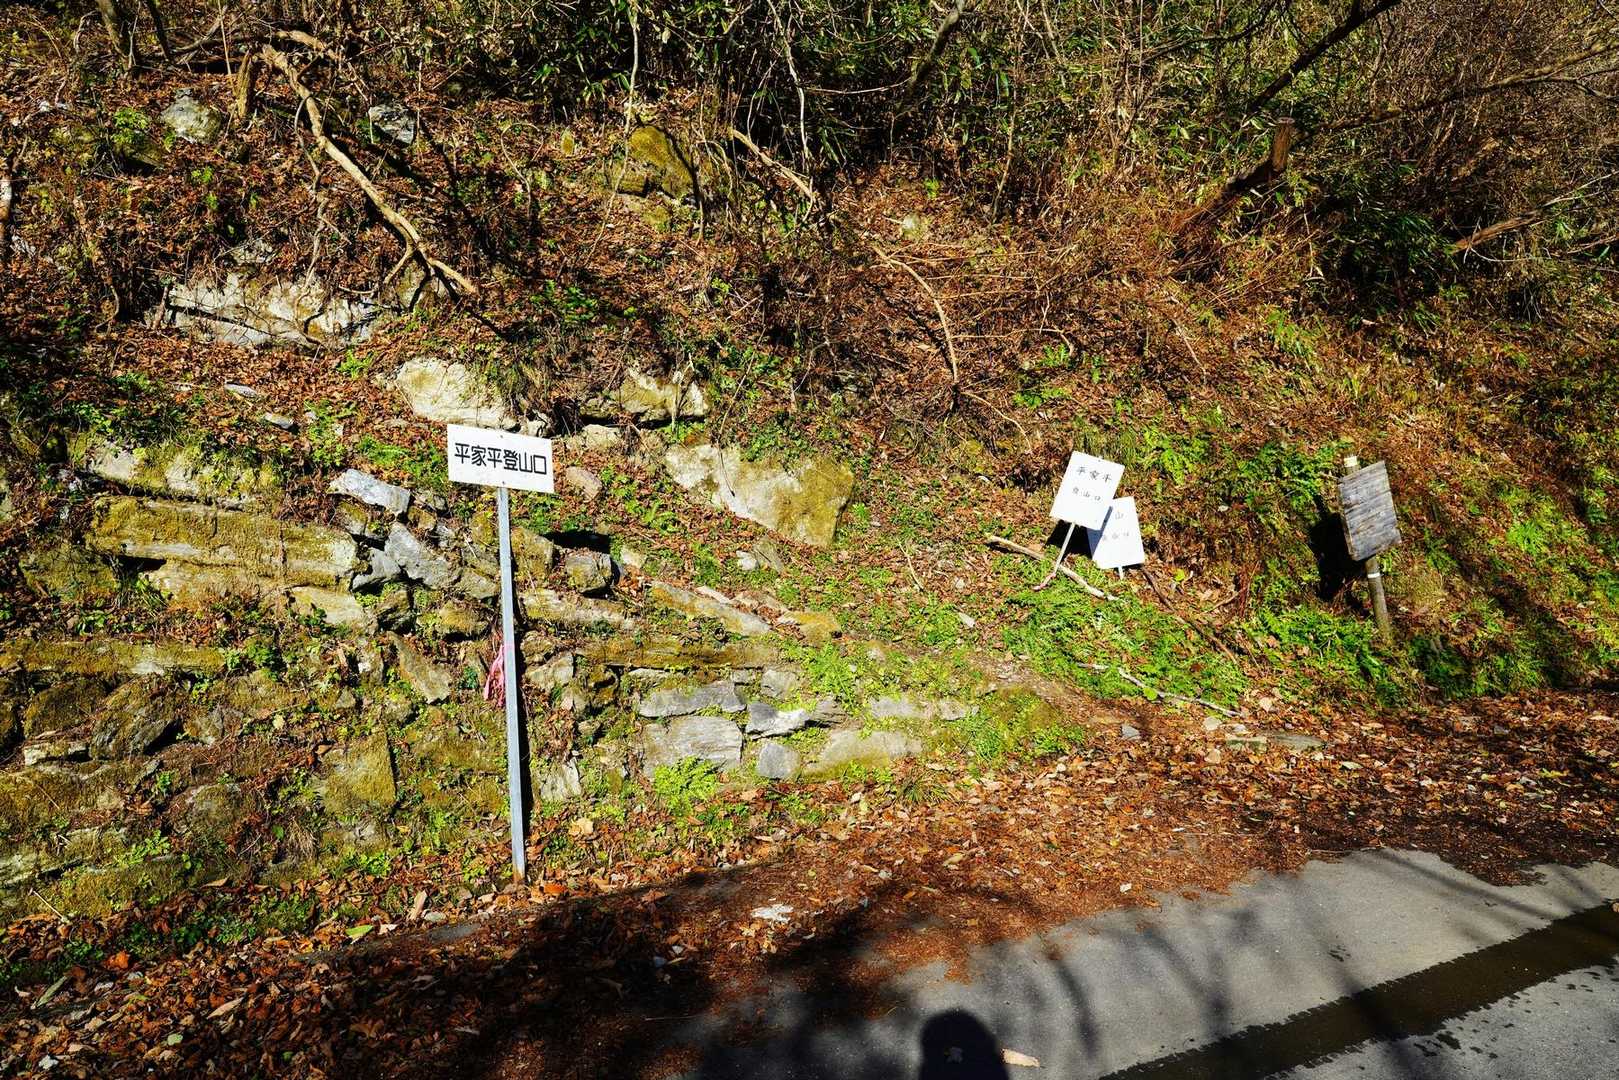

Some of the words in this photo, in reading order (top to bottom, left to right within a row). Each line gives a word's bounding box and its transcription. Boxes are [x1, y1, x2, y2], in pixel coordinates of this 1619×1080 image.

[454, 442, 548, 475] 平家平登山口
